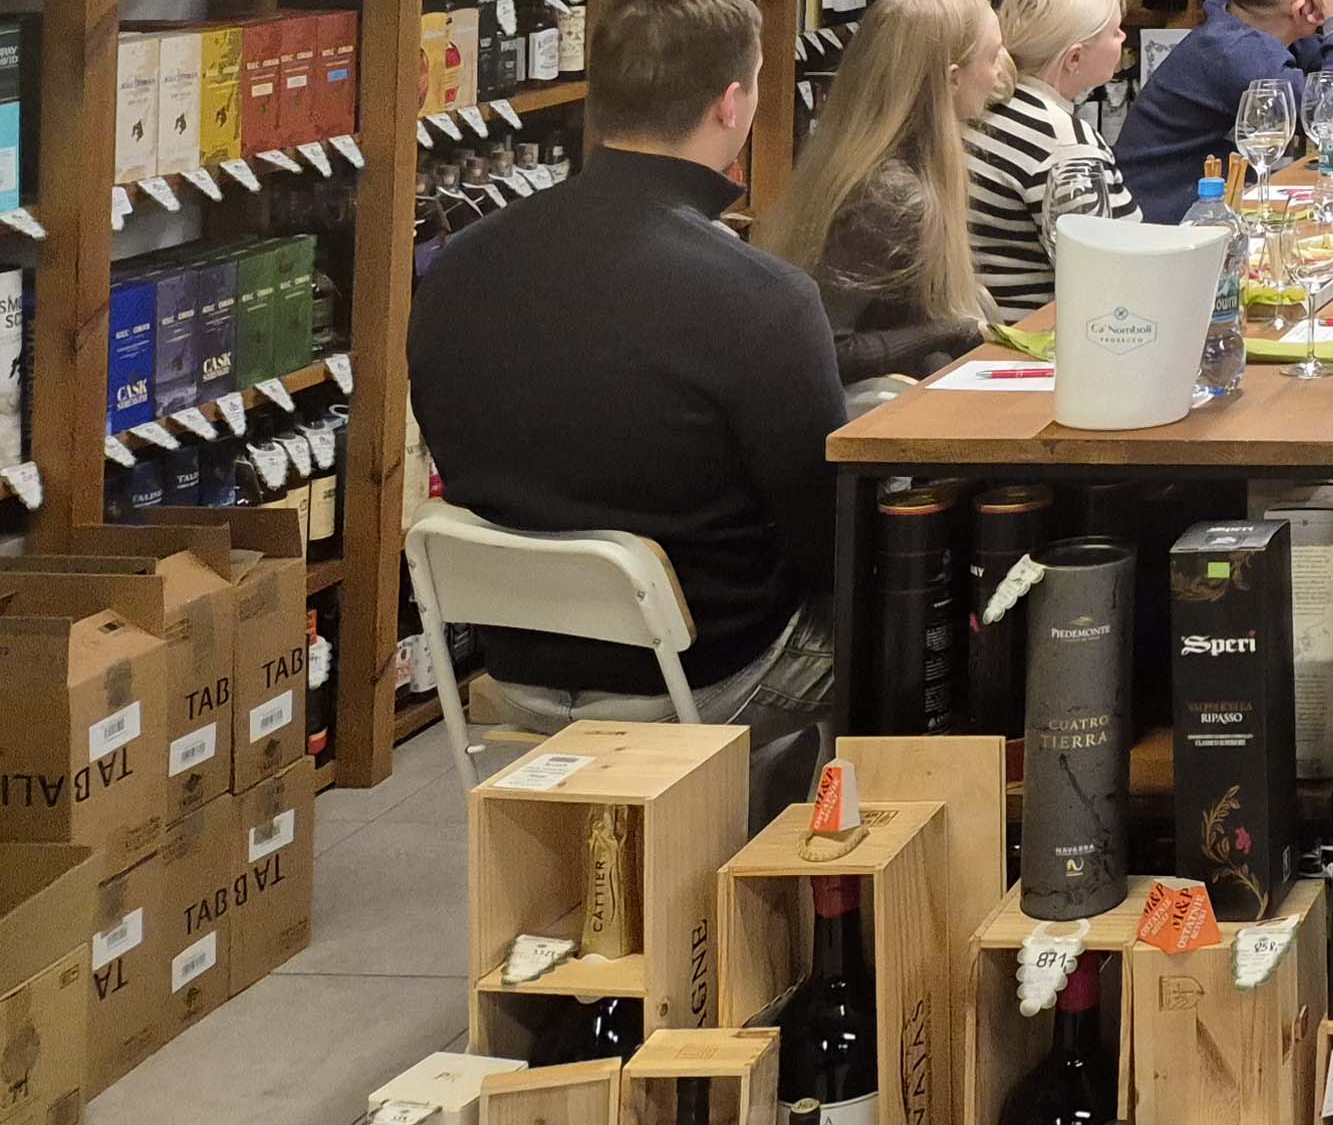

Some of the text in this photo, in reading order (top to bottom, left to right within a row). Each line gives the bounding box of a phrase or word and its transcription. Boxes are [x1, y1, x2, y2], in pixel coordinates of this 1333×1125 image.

[203, 352, 232, 375] CASK
[117, 379, 148, 402] CASK
[1050, 625, 1112, 640] PIEDEMONTE
[1181, 630, 1256, 656] Speri
[185, 677, 229, 720] TAB
[1048, 714, 1110, 731] CUATRO
[1200, 712, 1243, 724] RIPASSO
[1040, 732, 1108, 750] TIERRA
[1055, 843, 1096, 855] NAVARRA
[593, 860, 606, 932] CATTIER
[184, 892, 227, 934] TAB
